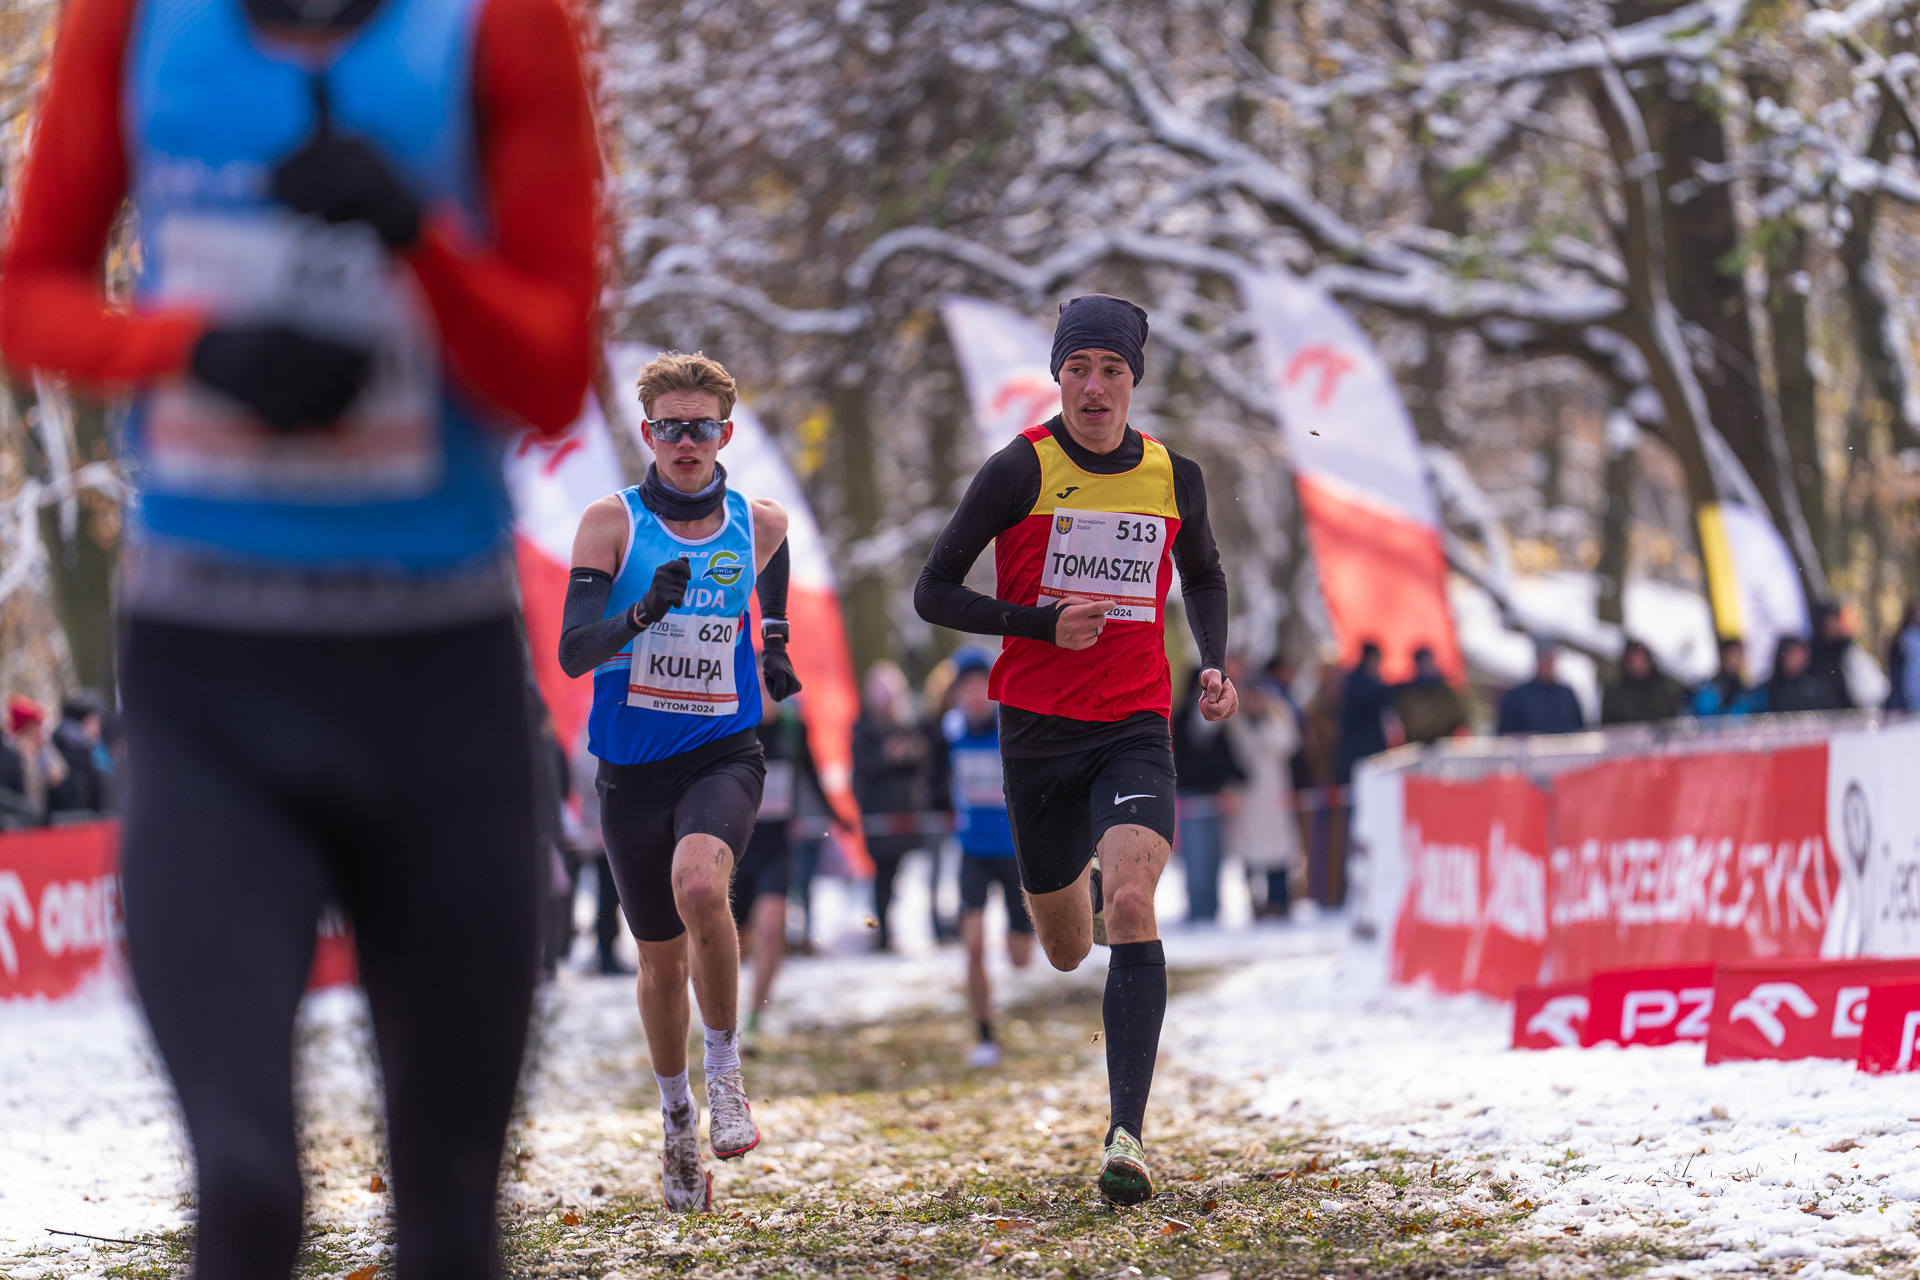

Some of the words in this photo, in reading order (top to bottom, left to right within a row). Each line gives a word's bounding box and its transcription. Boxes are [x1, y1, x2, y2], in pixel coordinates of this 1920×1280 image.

[1116, 520, 1157, 543] 513
[712, 567, 734, 575] GWDA
[1053, 553, 1154, 583] TOMASZEK
[698, 623, 733, 644] 620
[649, 653, 722, 681] KULPA
[653, 700, 689, 712] BYTOM
[691, 703, 715, 713] 2024
